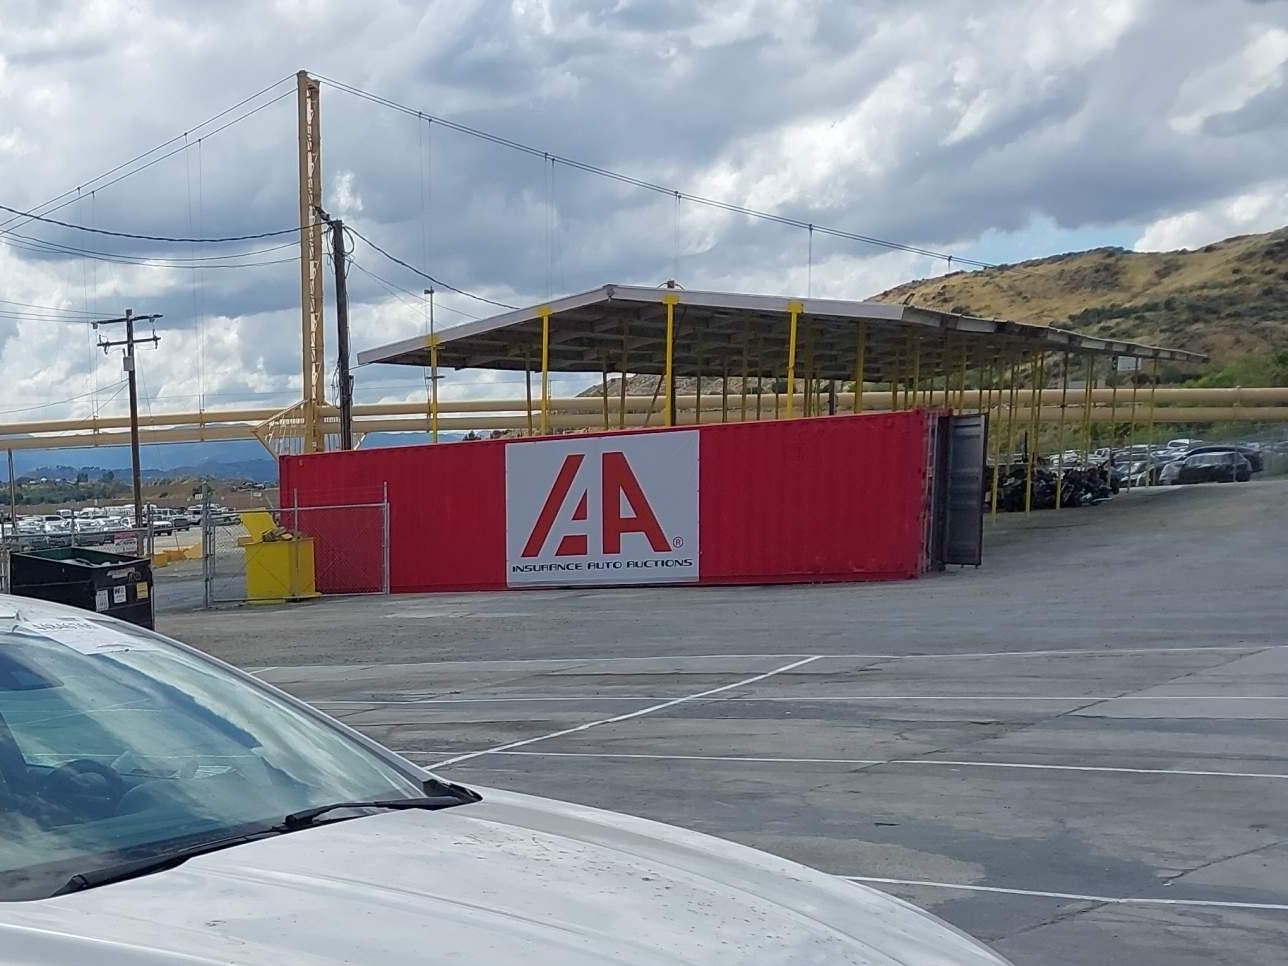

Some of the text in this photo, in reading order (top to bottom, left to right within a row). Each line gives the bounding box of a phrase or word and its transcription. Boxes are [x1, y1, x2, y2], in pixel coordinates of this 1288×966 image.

[512, 558, 694, 573] INSURANCE AUTO AUCTIONS
